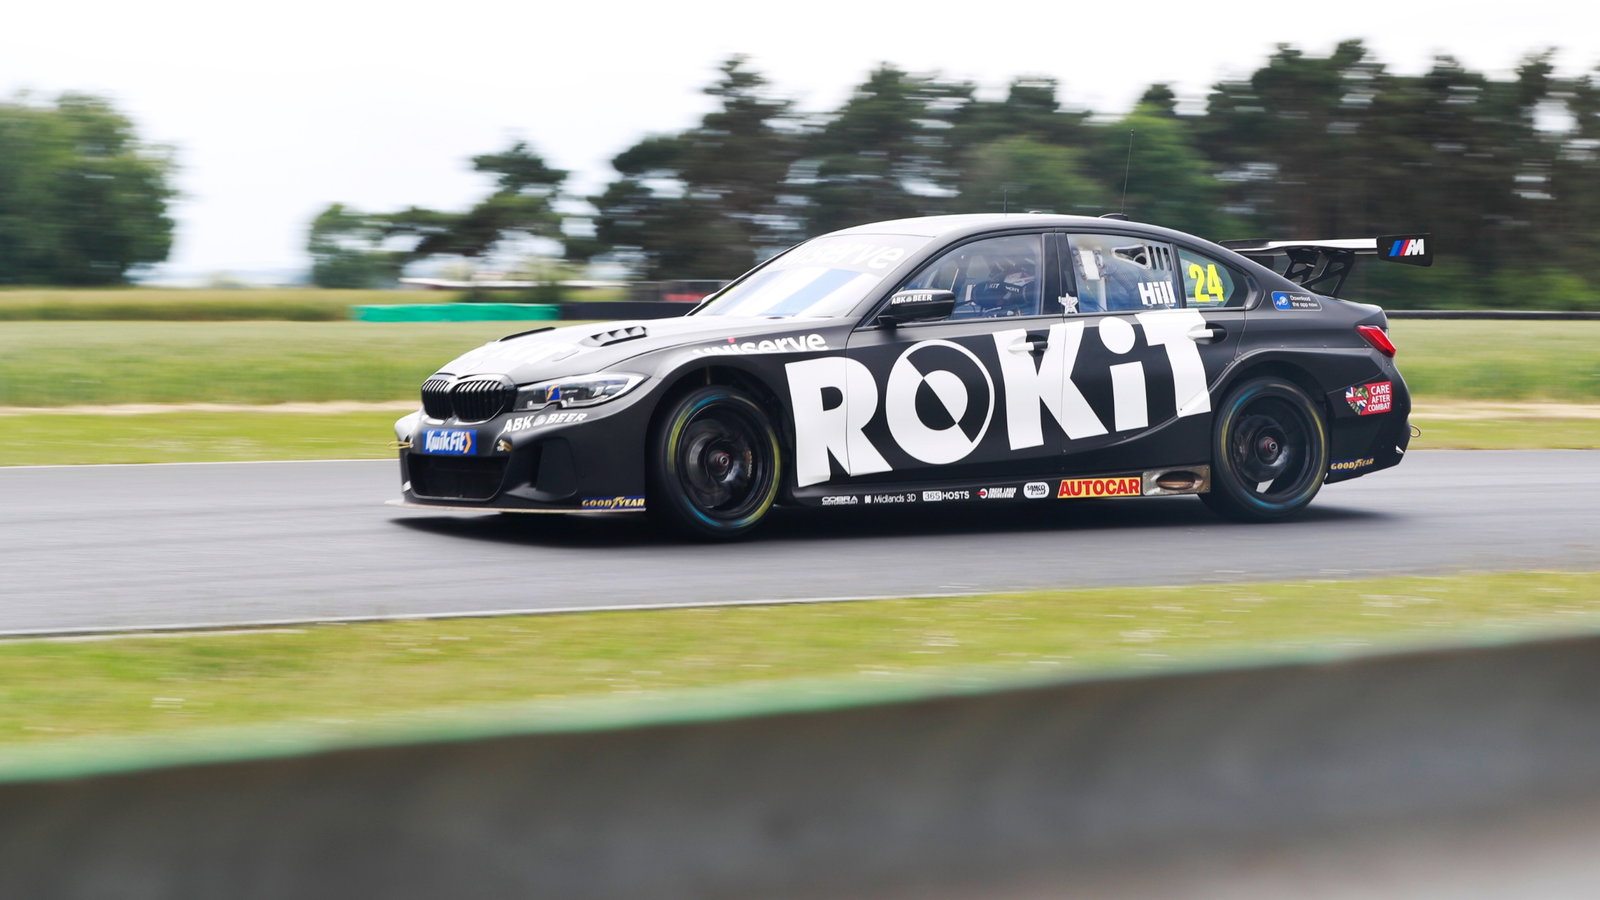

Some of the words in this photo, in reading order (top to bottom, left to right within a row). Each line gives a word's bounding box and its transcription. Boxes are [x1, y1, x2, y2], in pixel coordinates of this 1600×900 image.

[1188, 263, 1224, 302] 24
[891, 296, 906, 305] ABK
[912, 293, 933, 302] BEER
[1137, 281, 1176, 305] Hill
[1370, 384, 1390, 395] CARE
[1371, 394, 1391, 404] AFTER
[1367, 402, 1391, 412] COMBAT
[501, 415, 535, 434] ABK
[544, 412, 588, 426] BEER
[1330, 458, 1375, 470] GOODYEAR
[1058, 478, 1141, 497] AUTOCAR
[582, 496, 646, 509] GOODYEAR
[821, 495, 859, 504] COBRA
[873, 493, 905, 504] Midlands
[906, 493, 917, 502] 3D
